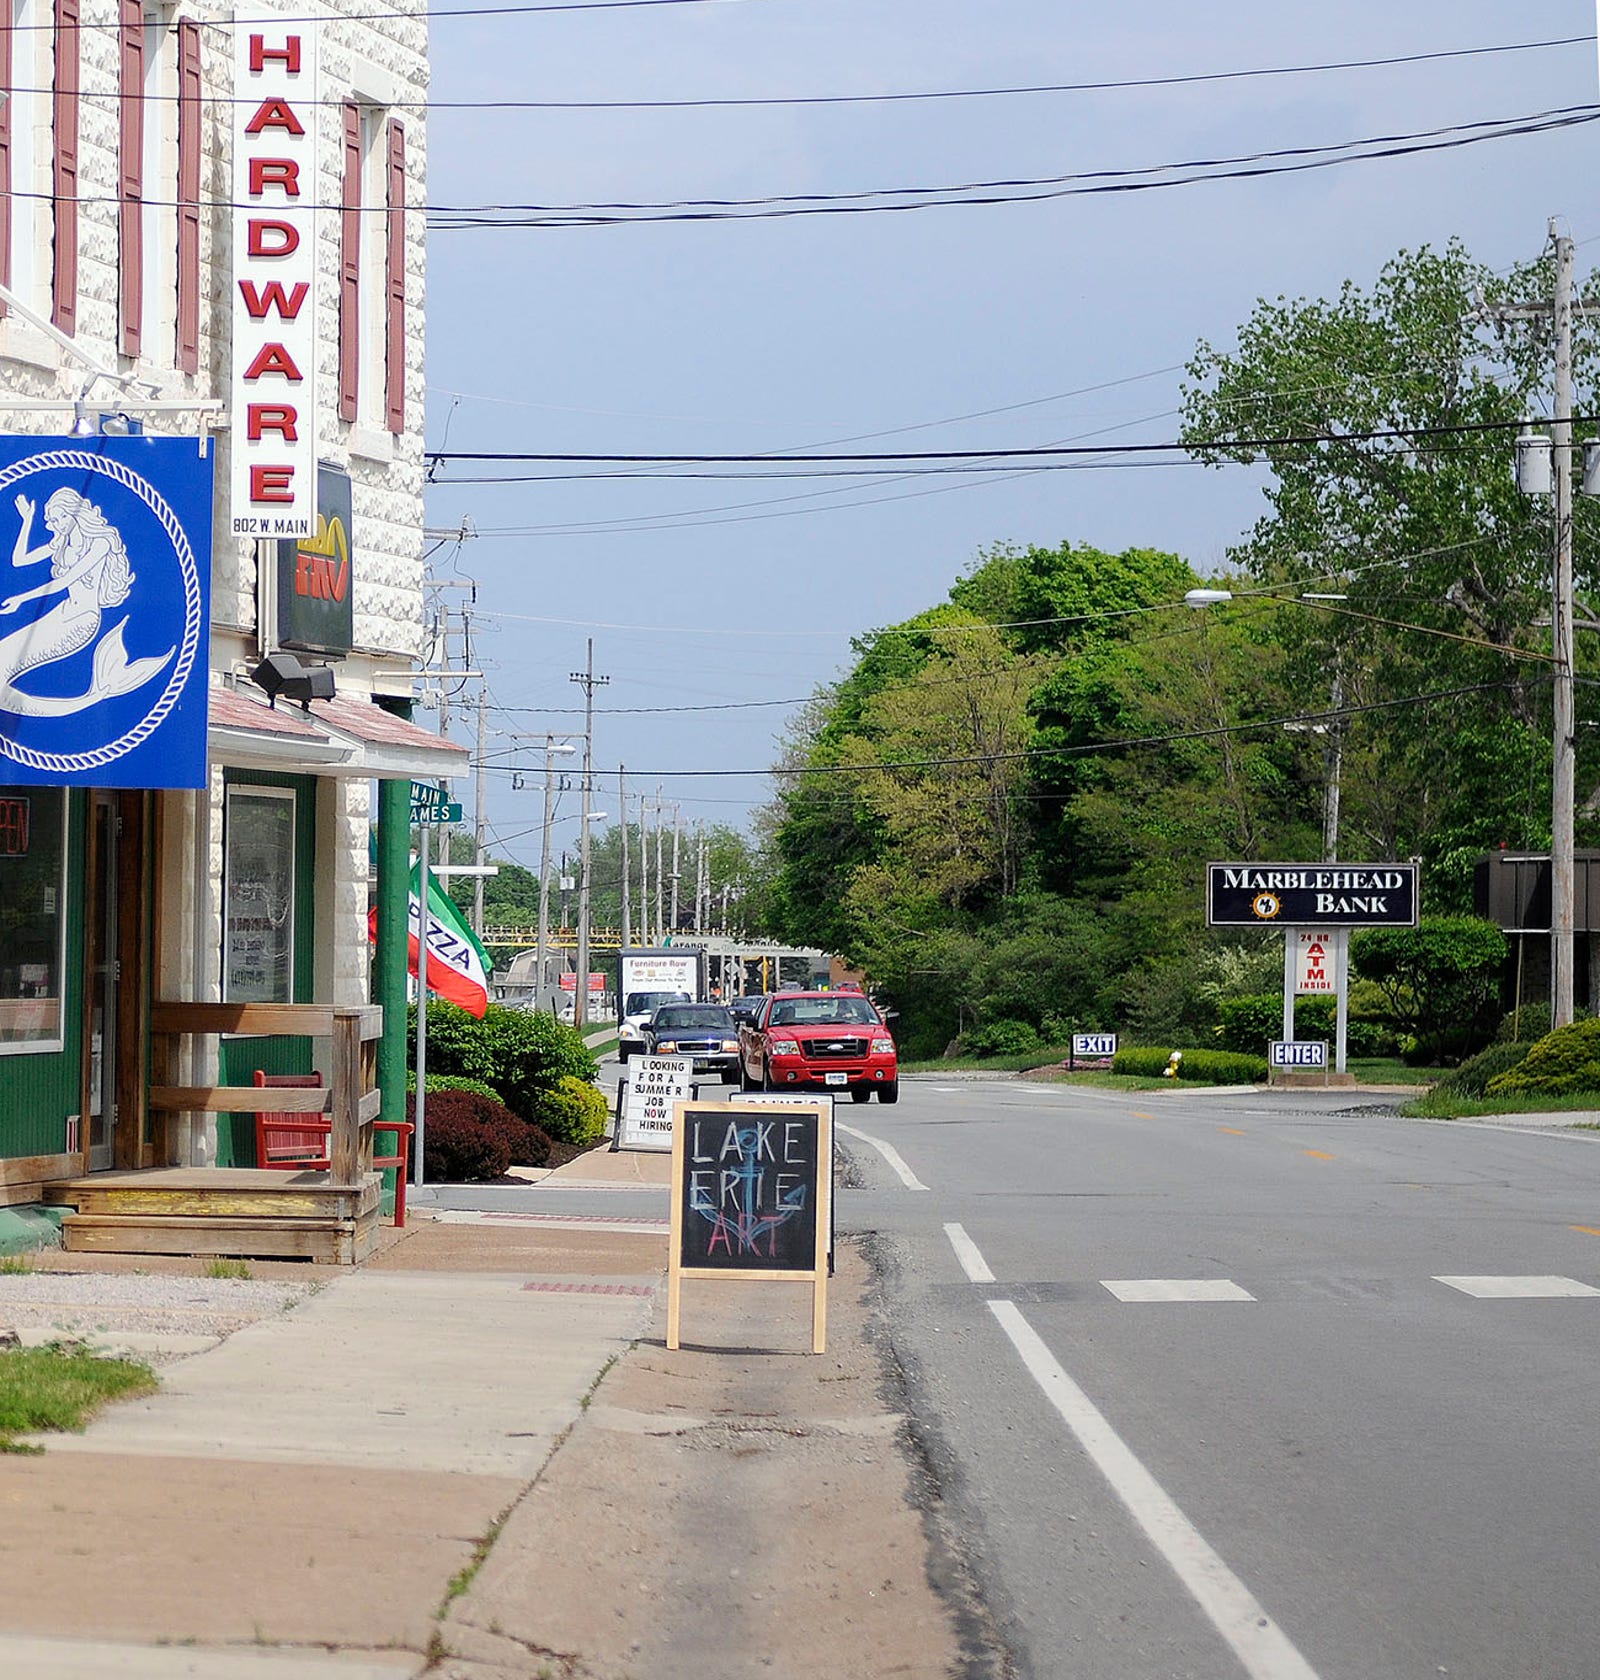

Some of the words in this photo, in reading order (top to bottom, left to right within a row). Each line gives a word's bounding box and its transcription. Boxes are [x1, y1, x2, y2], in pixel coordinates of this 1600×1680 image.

[238, 33, 310, 503] HARDWARE
[233, 518, 257, 533] 802
[274, 519, 308, 534] MAIN
[410, 783, 440, 805] MAIN
[410, 806, 450, 821] AMES
[1223, 869, 1403, 889] MARBLEHEAD
[1315, 893, 1388, 913] BANK
[408, 902, 469, 970] PZZA
[1300, 934, 1311, 942] 24
[1307, 943, 1325, 979] ATM
[1076, 1037, 1113, 1052] EXIT
[1274, 1044, 1322, 1064] ENTER
[642, 1060, 685, 1071] LOOKING
[639, 1073, 663, 1082] FOR
[668, 1074, 674, 1083] A
[635, 1084, 682, 1095] SUMMER
[645, 1097, 664, 1106] JOB
[644, 1109, 667, 1118] NOW
[639, 1121, 672, 1131] HIRING
[691, 1121, 806, 1163] LAKE
[691, 1170, 804, 1210] ERIE
[707, 1211, 785, 1257] ART
